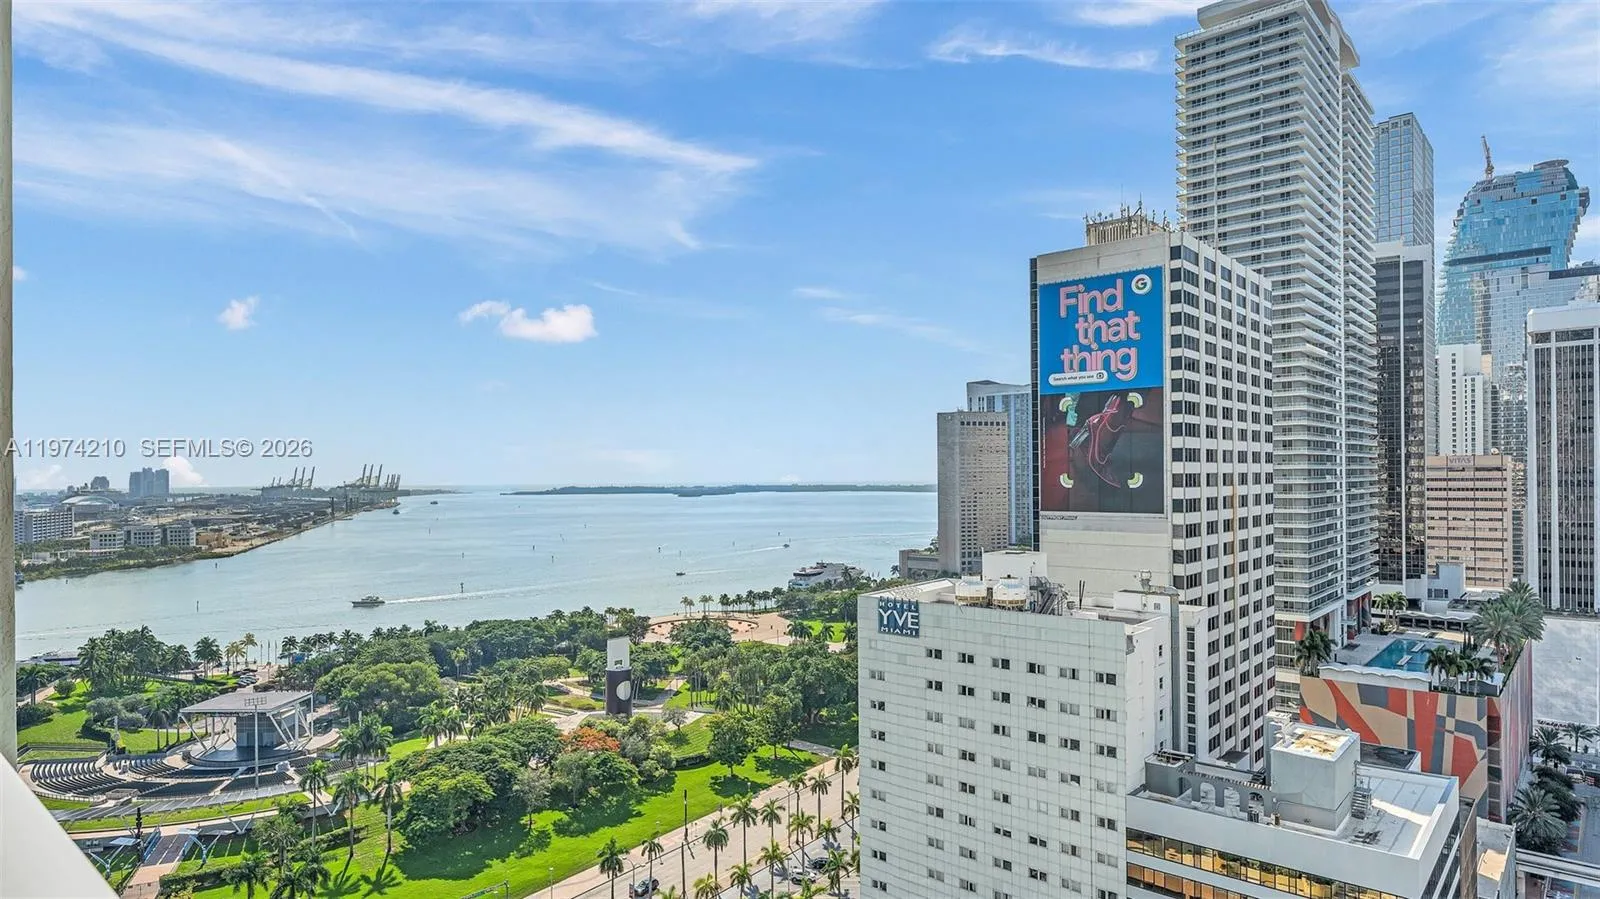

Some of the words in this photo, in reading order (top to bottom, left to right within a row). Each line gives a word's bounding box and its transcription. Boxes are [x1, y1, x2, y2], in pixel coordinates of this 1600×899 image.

[1135, 278, 1147, 290] G
[1059, 278, 1124, 318] Find
[1075, 310, 1141, 349] that
[1060, 344, 1138, 381] thing
[880, 602, 916, 610] HOTEL
[879, 609, 919, 628] YVE
[881, 627, 915, 635] MIAMI
